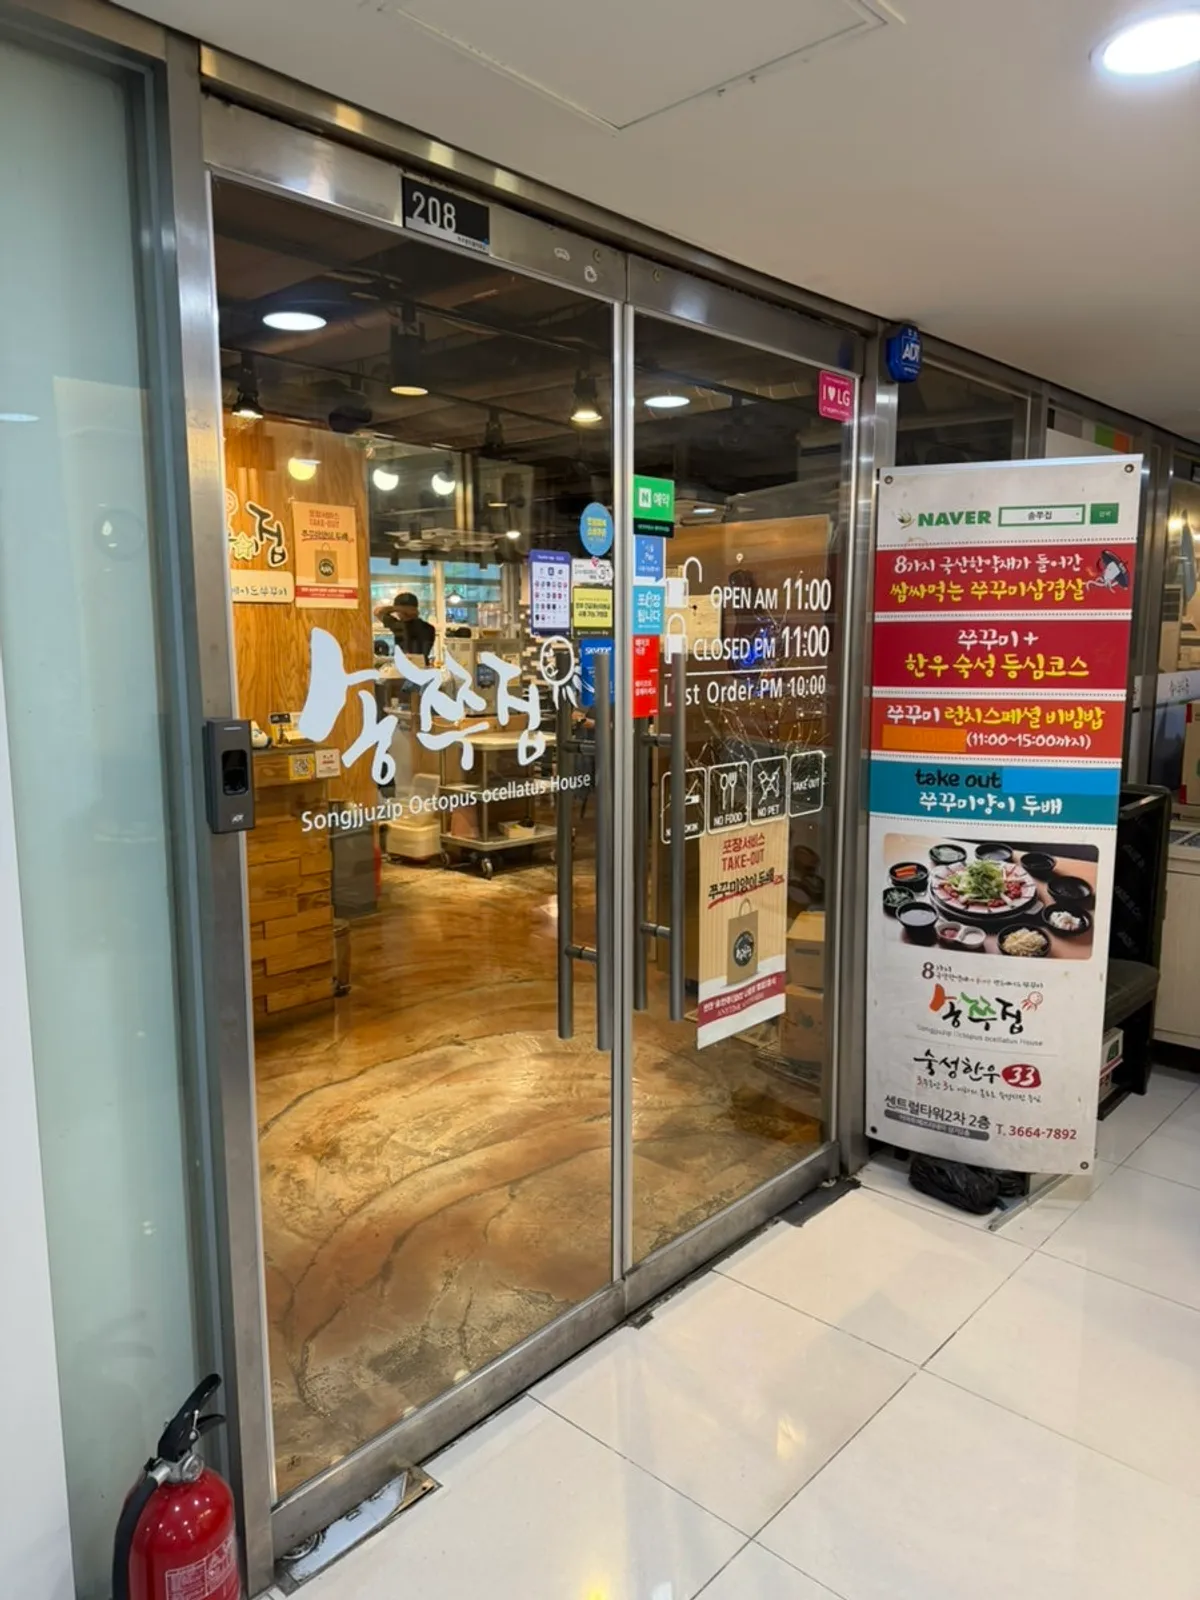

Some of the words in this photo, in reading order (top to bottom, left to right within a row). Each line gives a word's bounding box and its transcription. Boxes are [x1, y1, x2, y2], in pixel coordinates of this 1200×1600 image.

[412, 191, 456, 232] 208
[837, 388, 851, 407] LG
[917, 510, 992, 527] NAVER
[1027, 510, 1053, 521] 송쭈집
[894, 555, 936, 575] 8가지
[940, 554, 1031, 575] 국산한약재가
[1035, 553, 1083, 574] 들어간
[710, 585, 753, 609] OPEN
[754, 587, 778, 610] AM
[783, 578, 832, 611] 11:00
[890, 581, 965, 604] 쌈싸먹는
[970, 577, 1087, 603] 쭈꾸미삼겹살
[693, 637, 750, 662] CLOSED
[754, 636, 776, 660] PM
[781, 625, 830, 659] 11:00
[957, 628, 1019, 650] 쭈꾸미
[905, 653, 950, 678] 한우
[953, 653, 997, 679] 숙성
[1001, 653, 1090, 681] 등심코스
[664, 684, 701, 707] Lst
[706, 681, 754, 705] Order
[760, 678, 783, 698] PM
[788, 674, 826, 699] 10:00
[886, 704, 941, 726] 쭈꾸미
[944, 705, 1042, 730] 런치스페셜
[1045, 706, 1106, 731] 비빔밥
[792, 781, 807, 792] TAKE
[808, 778, 820, 789] OUT
[915, 767, 960, 788] take
[964, 771, 1002, 789] out
[301, 802, 404, 833] Songjjuzip
[409, 790, 478, 815] Octopus
[481, 779, 547, 804] ocellatus
[550, 774, 592, 793] House
[757, 807, 767, 818] NO
[767, 804, 780, 815] PET
[918, 791, 1015, 815] 쭈꾸미양이
[1022, 797, 1063, 817] 두배
[713, 816, 724, 826] NO
[724, 811, 743, 825] FOOD
[721, 848, 765, 872] TAKE-OUT
[921, 961, 934, 981] 8
[912, 1048, 1001, 1084] 숙성한우
[1007, 1065, 1036, 1087] 33
[884, 1094, 966, 1126] 센트럴타워2차
[968, 1113, 991, 1130] 2층
[1008, 1124, 1077, 1141] 3664-7892
